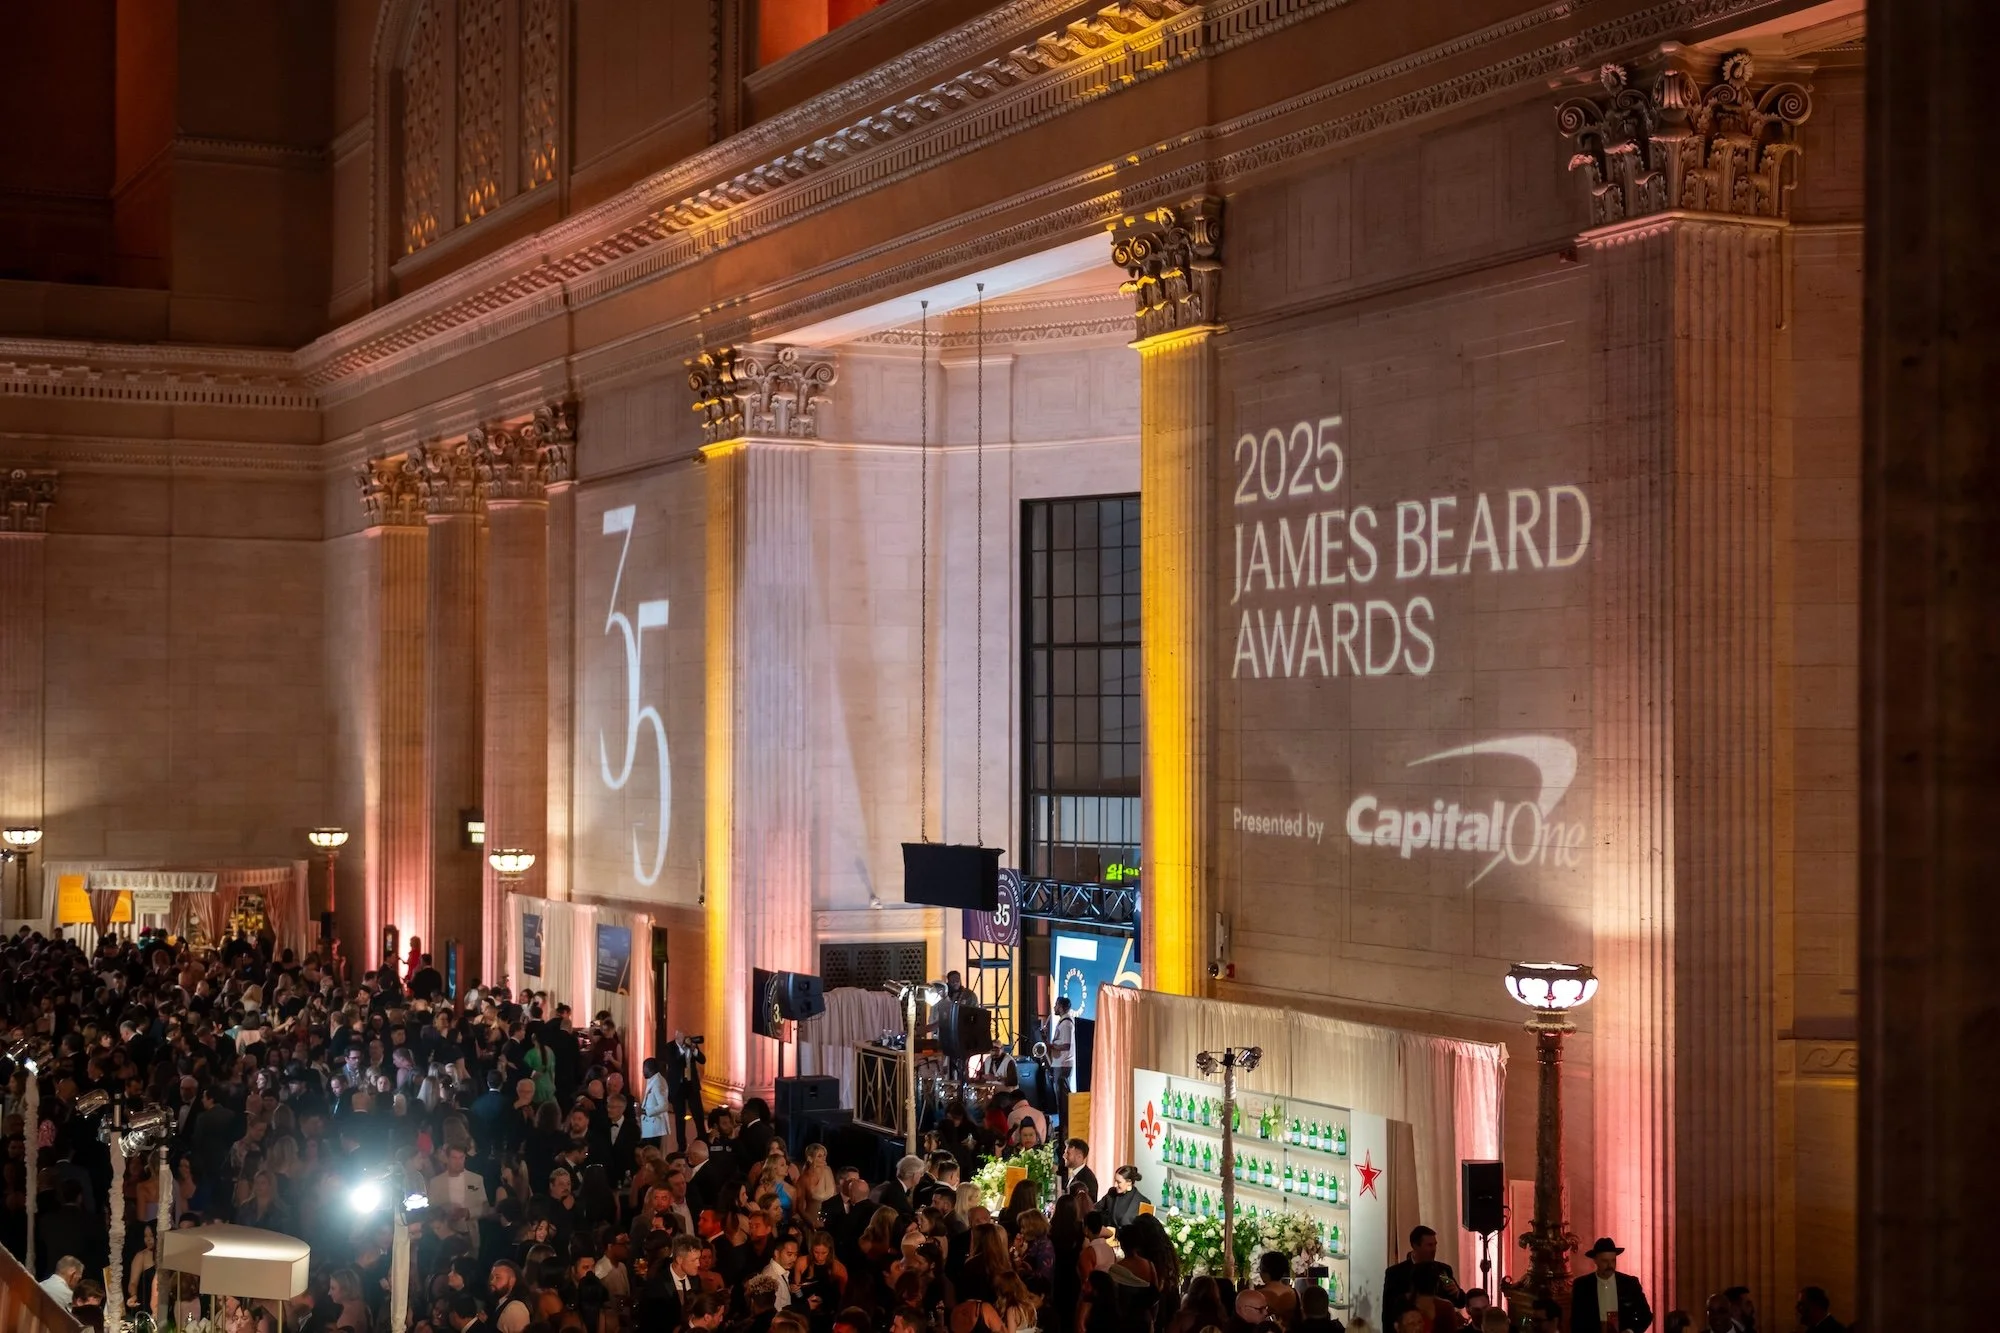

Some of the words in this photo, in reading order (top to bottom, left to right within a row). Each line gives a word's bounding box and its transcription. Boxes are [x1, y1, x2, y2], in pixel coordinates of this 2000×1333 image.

[1233, 415, 1344, 505] 2025
[1231, 504, 1379, 605] JAMES
[1395, 484, 1592, 580] BEARD
[1231, 596, 1436, 680] AWARDS
[600, 504, 671, 886] 35
[1233, 806, 1302, 838] Presented
[1307, 813, 1325, 844] by
[1346, 794, 1506, 860] Capital
[1504, 800, 1586, 868] One
[993, 902, 1010, 926] 35
[1076, 969, 1088, 999] BEARD
